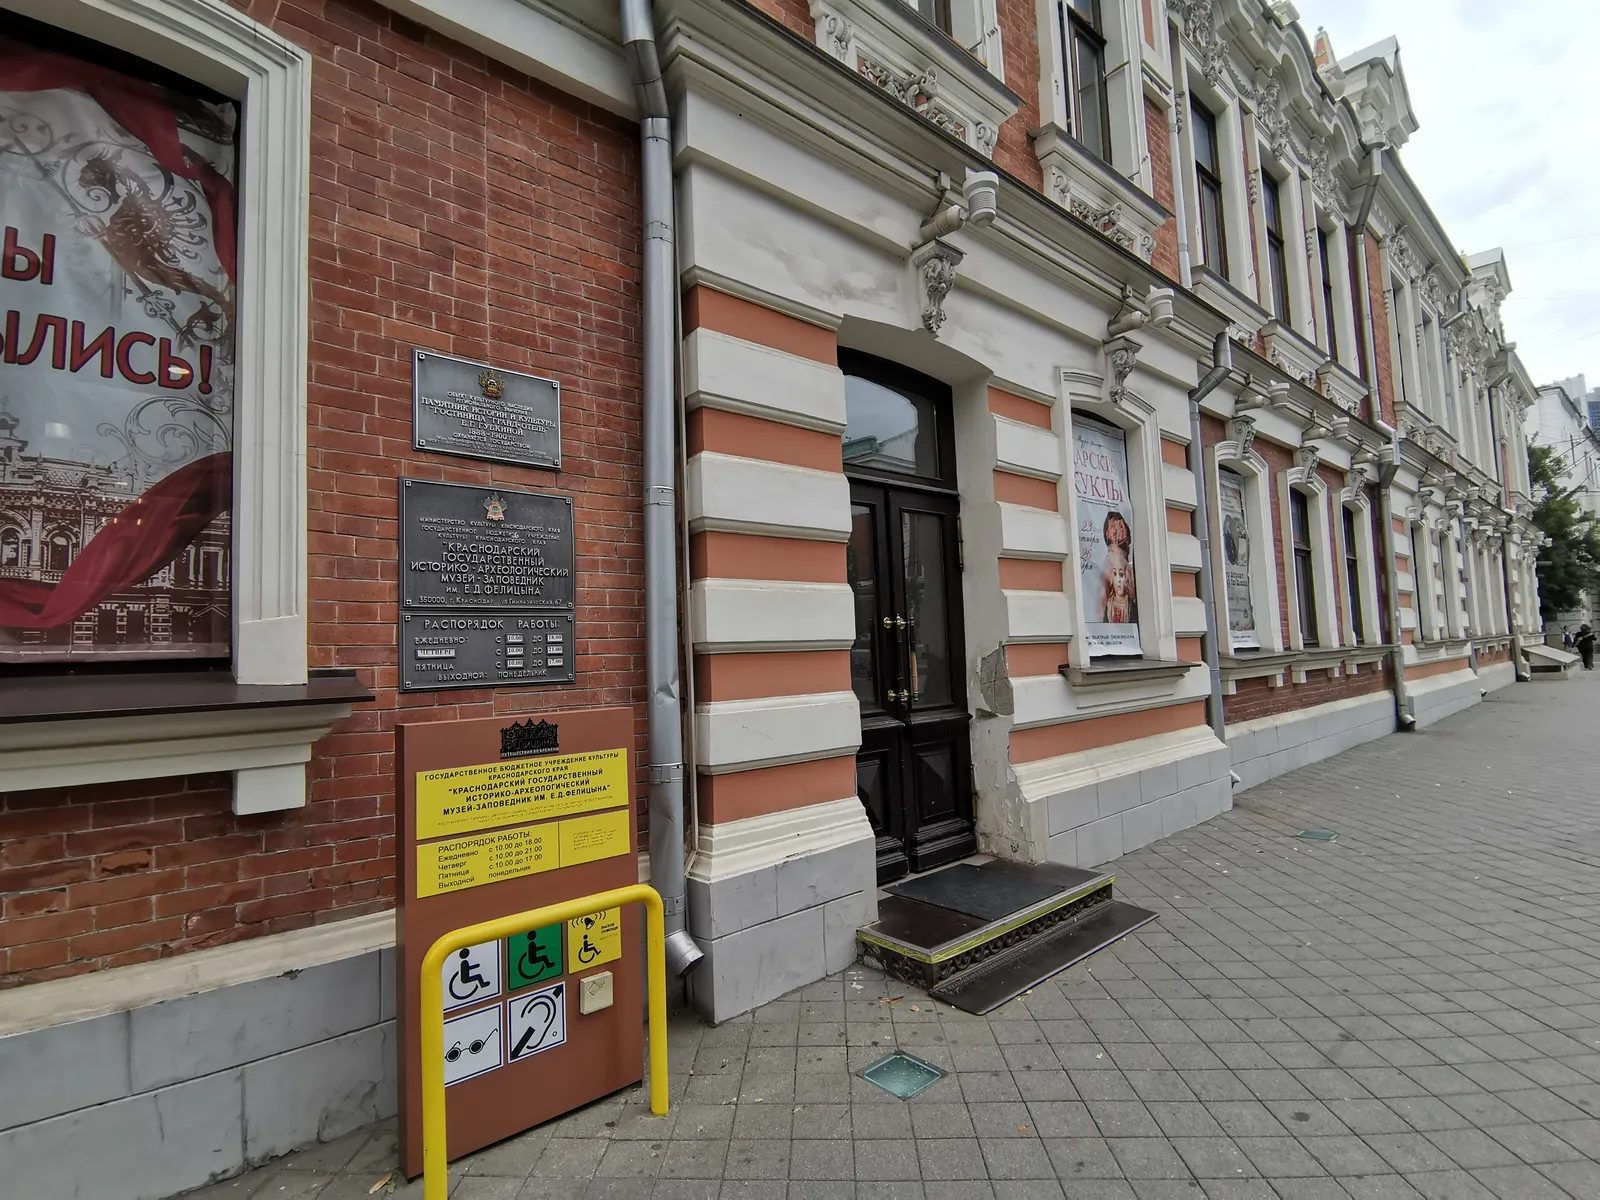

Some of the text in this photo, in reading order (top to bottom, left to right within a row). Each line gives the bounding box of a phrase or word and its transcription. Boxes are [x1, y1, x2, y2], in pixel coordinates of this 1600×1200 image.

[420, 396, 469, 412] ПАМЯТНИК
[471, 405, 507, 419] ИСТОРИИ
[518, 415, 556, 428] КУЛЬТУРЫ
[453, 432, 487, 442] ОХРАНЯЕТСЯ
[489, 438, 531, 449] ГОСУДАРСТВОМ
[419, 517, 466, 526] МИНИСТЕРСТВО
[501, 524, 544, 532] КРАСНОДАРСКОГО
[421, 525, 477, 534] ГОСУДАРСТВЕННОЕ
[475, 535, 526, 544] КРАСНОДАРСКОГО
[442, 551, 545, 567] ГОСУДАРСТВЕННЫЙ
[423, 619, 560, 630] РАСПОРЯДОК РАБОТЫ:
[414, 636, 469, 645] ЕЖЕДНЕВНО:
[415, 663, 455, 671] ПЯТНИЦА
[438, 669, 547, 681] ВЫХОДНОЙ: ПОНЕДЕЛЬНИК
[424, 752, 619, 781] ГОСУДАРСТВЕННОЕ БЮДЖЕТНОЕ УЧРЕЖДЕНИЕ КУЛЬТУРЫ
[488, 768, 551, 781] КРАСНОДАРСКОГО
[448, 767, 604, 795] "КРАСНОДАРСКИЙ ГОСУДАРСТВЕННЫЙ
[465, 778, 590, 802] ИСТОРИКО-АРХЕОЛОГИЧЕСКИЙ
[443, 784, 611, 815] МУЗЕЙ-ЗАПОВЕДНИК ИМ. Е.Д.ФЕЛИЦЫНА"
[438, 830, 532, 853] РАСПОРЯДОК РАБОТЫ:
[438, 850, 479, 862] Ежедневно
[495, 842, 513, 851] 10.00
[514, 841, 523, 849] до
[525, 837, 542, 846] 18.00
[438, 861, 467, 871] Четверг
[495, 850, 514, 859] 10.00
[524, 845, 542, 854] 21.00
[438, 869, 470, 880] Пятница
[495, 859, 514, 868] 10.00
[525, 853, 543, 862] 17.00
[438, 865, 532, 889] Выходной понедельник
